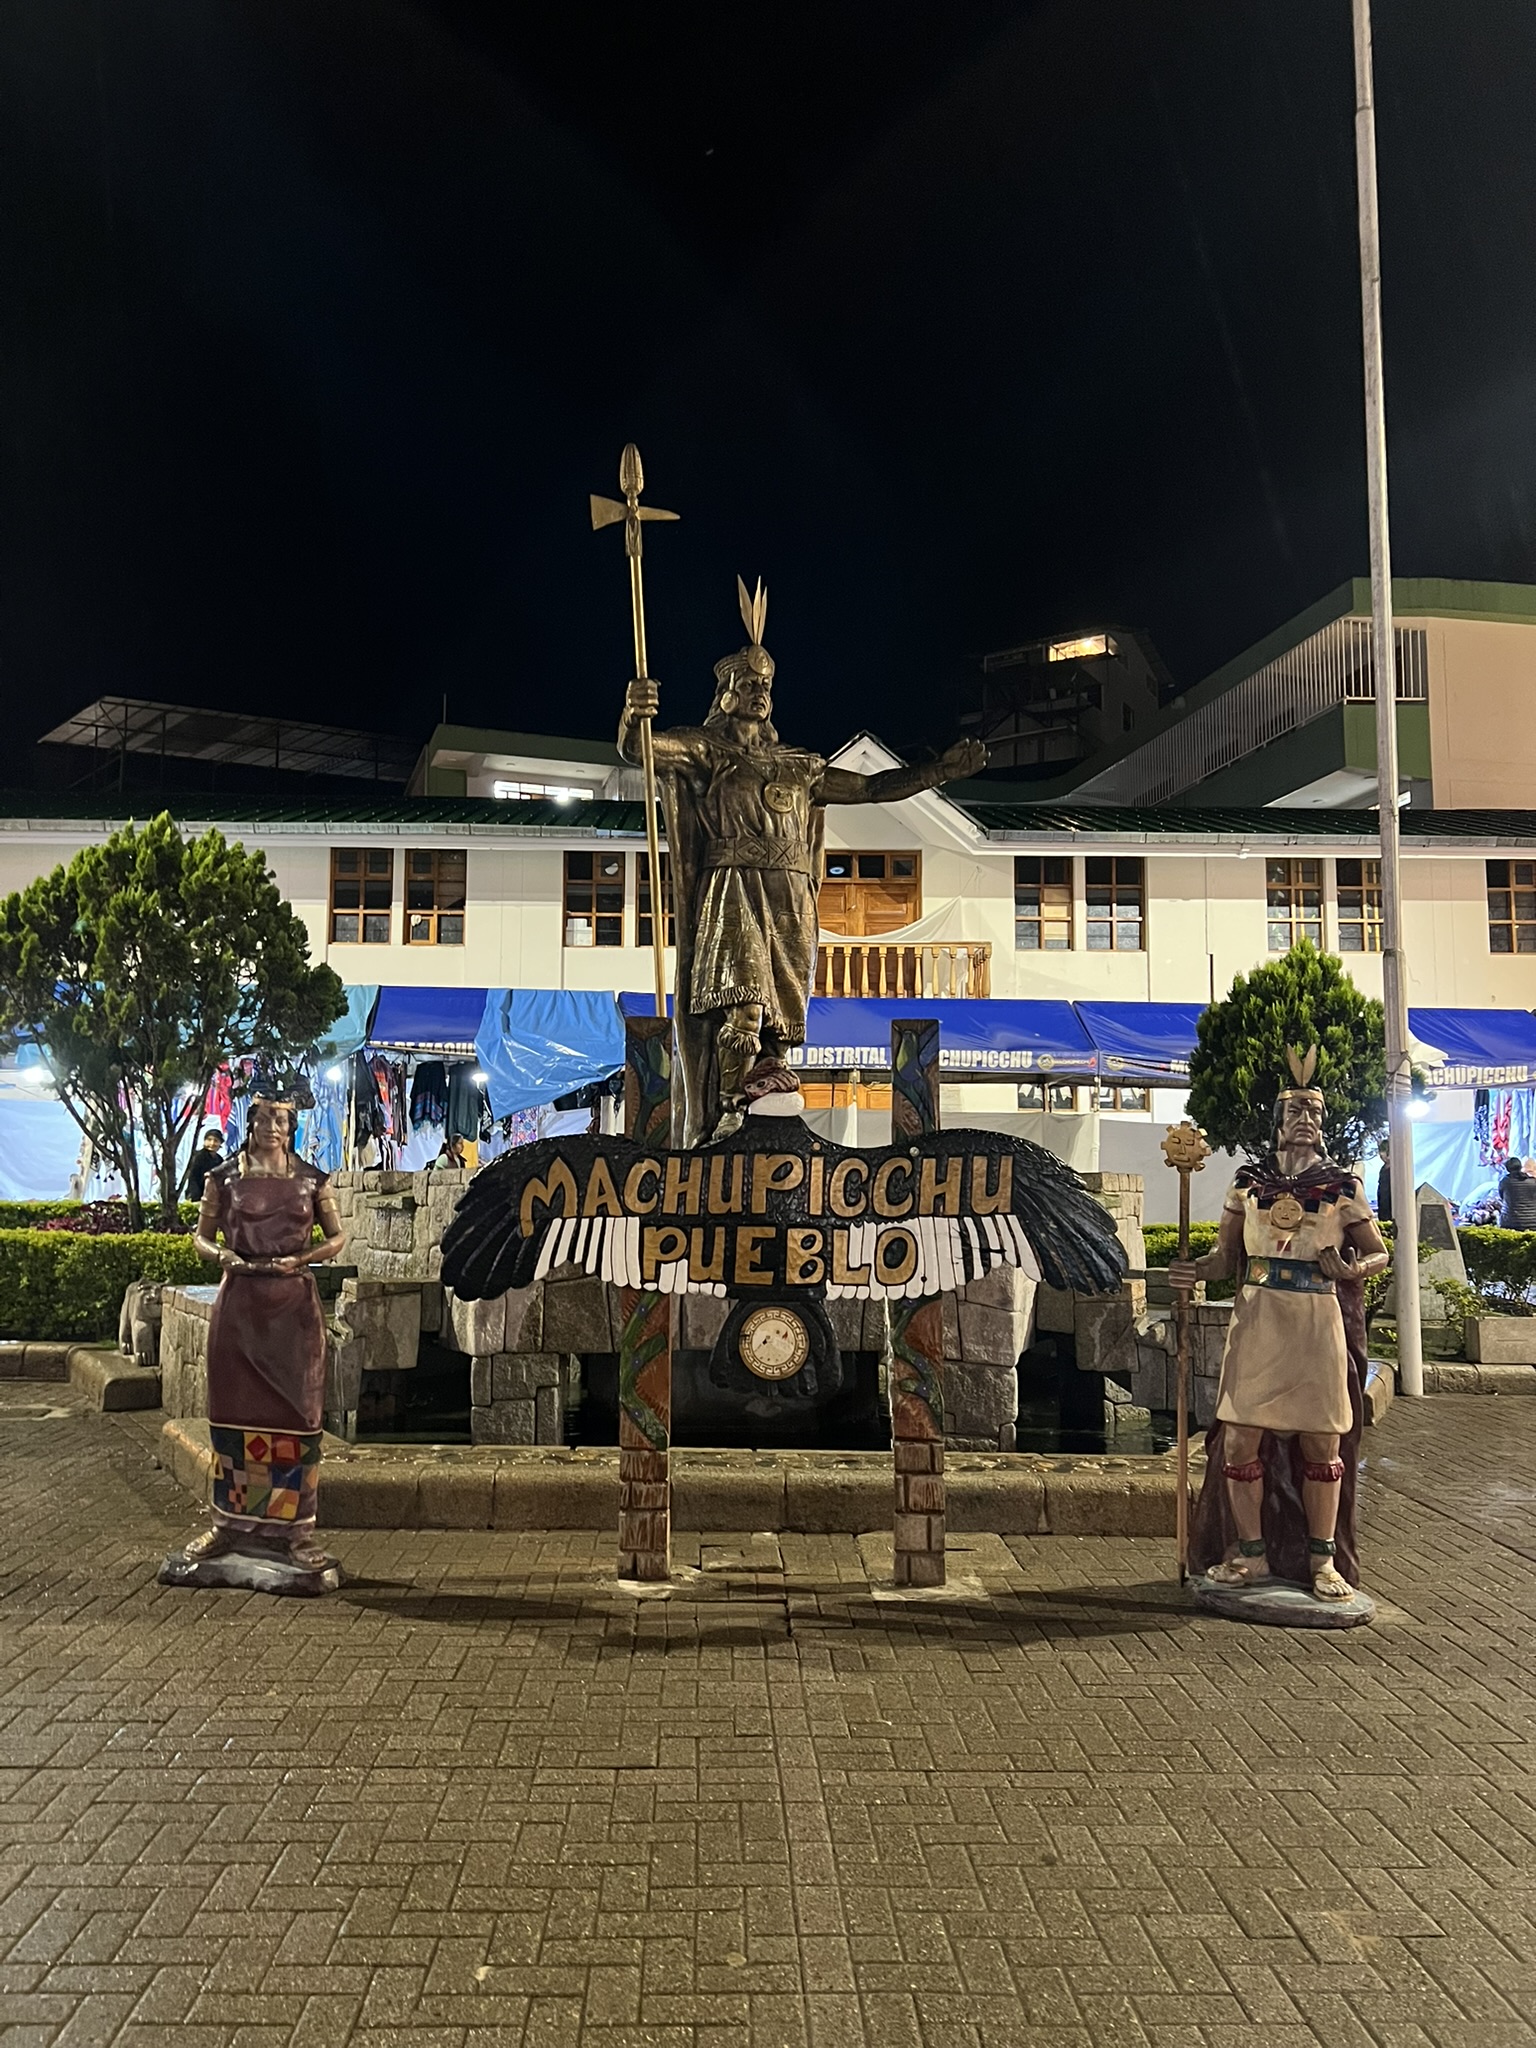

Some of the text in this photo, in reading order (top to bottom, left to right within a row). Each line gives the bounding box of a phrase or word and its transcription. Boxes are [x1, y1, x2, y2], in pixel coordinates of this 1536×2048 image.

[806, 1047, 888, 1065] DISTRITAL
[519, 1142, 1014, 1238] MACHUPICCHU
[642, 1223, 917, 1286] PUEBLO
